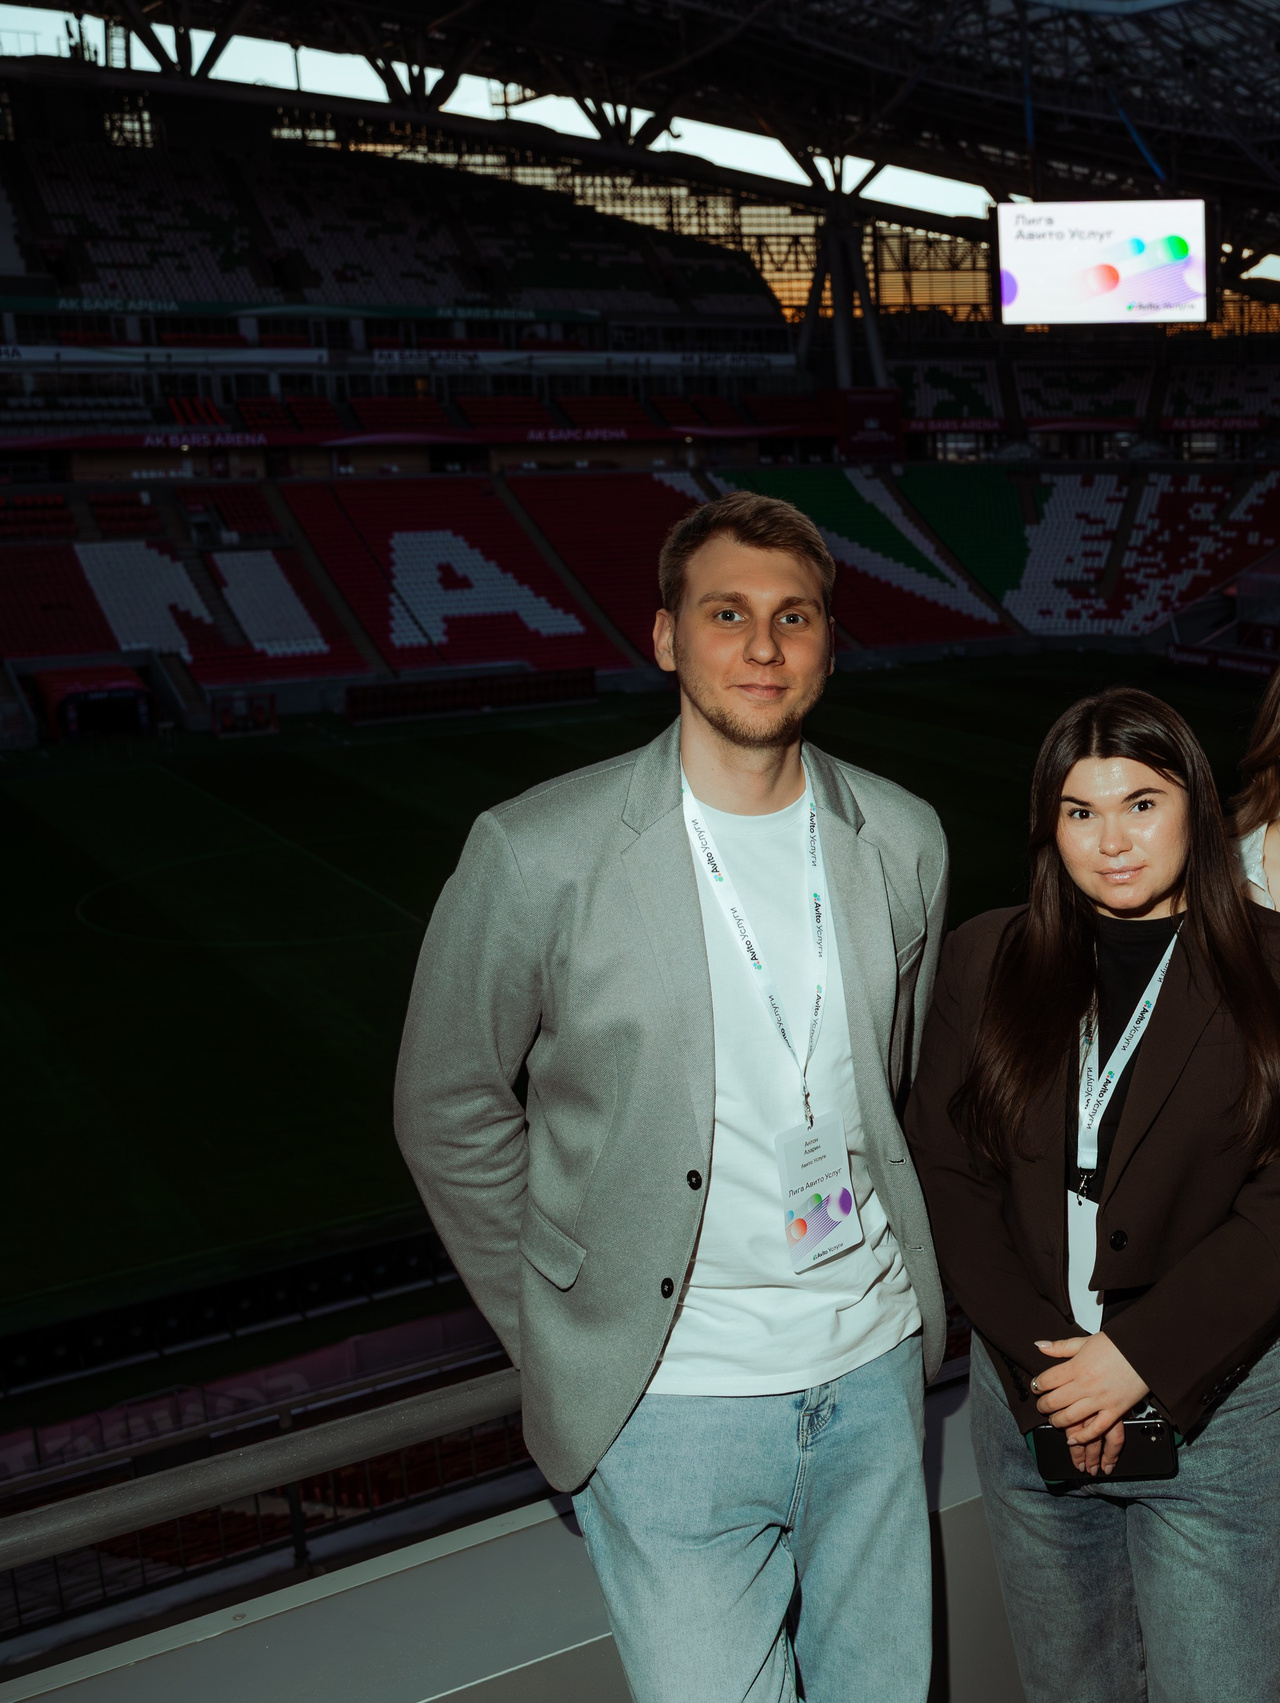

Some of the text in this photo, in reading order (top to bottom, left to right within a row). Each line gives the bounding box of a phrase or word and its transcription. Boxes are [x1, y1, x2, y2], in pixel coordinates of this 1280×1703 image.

[1014, 214, 1054, 227] Лига
[1014, 229, 1114, 241] Авито Услуг
[691, 818, 721, 873] Avito Услуги
[809, 834, 817, 867] Услуги
[730, 906, 758, 961] Avito Услуги
[768, 995, 783, 1028] Услуги
[1121, 1006, 1149, 1052] Avito Услуги
[1085, 1066, 1095, 1099] Услуги
[1098, 1077, 1112, 1099] Avito
[1086, 1097, 1104, 1130] Услуги
[804, 1137, 819, 1147] Антон
[800, 1154, 827, 1169] Авито Услуги
[788, 1168, 842, 1198] Лига Авито Услуг
[817, 1242, 844, 1259] Avito Услуги
